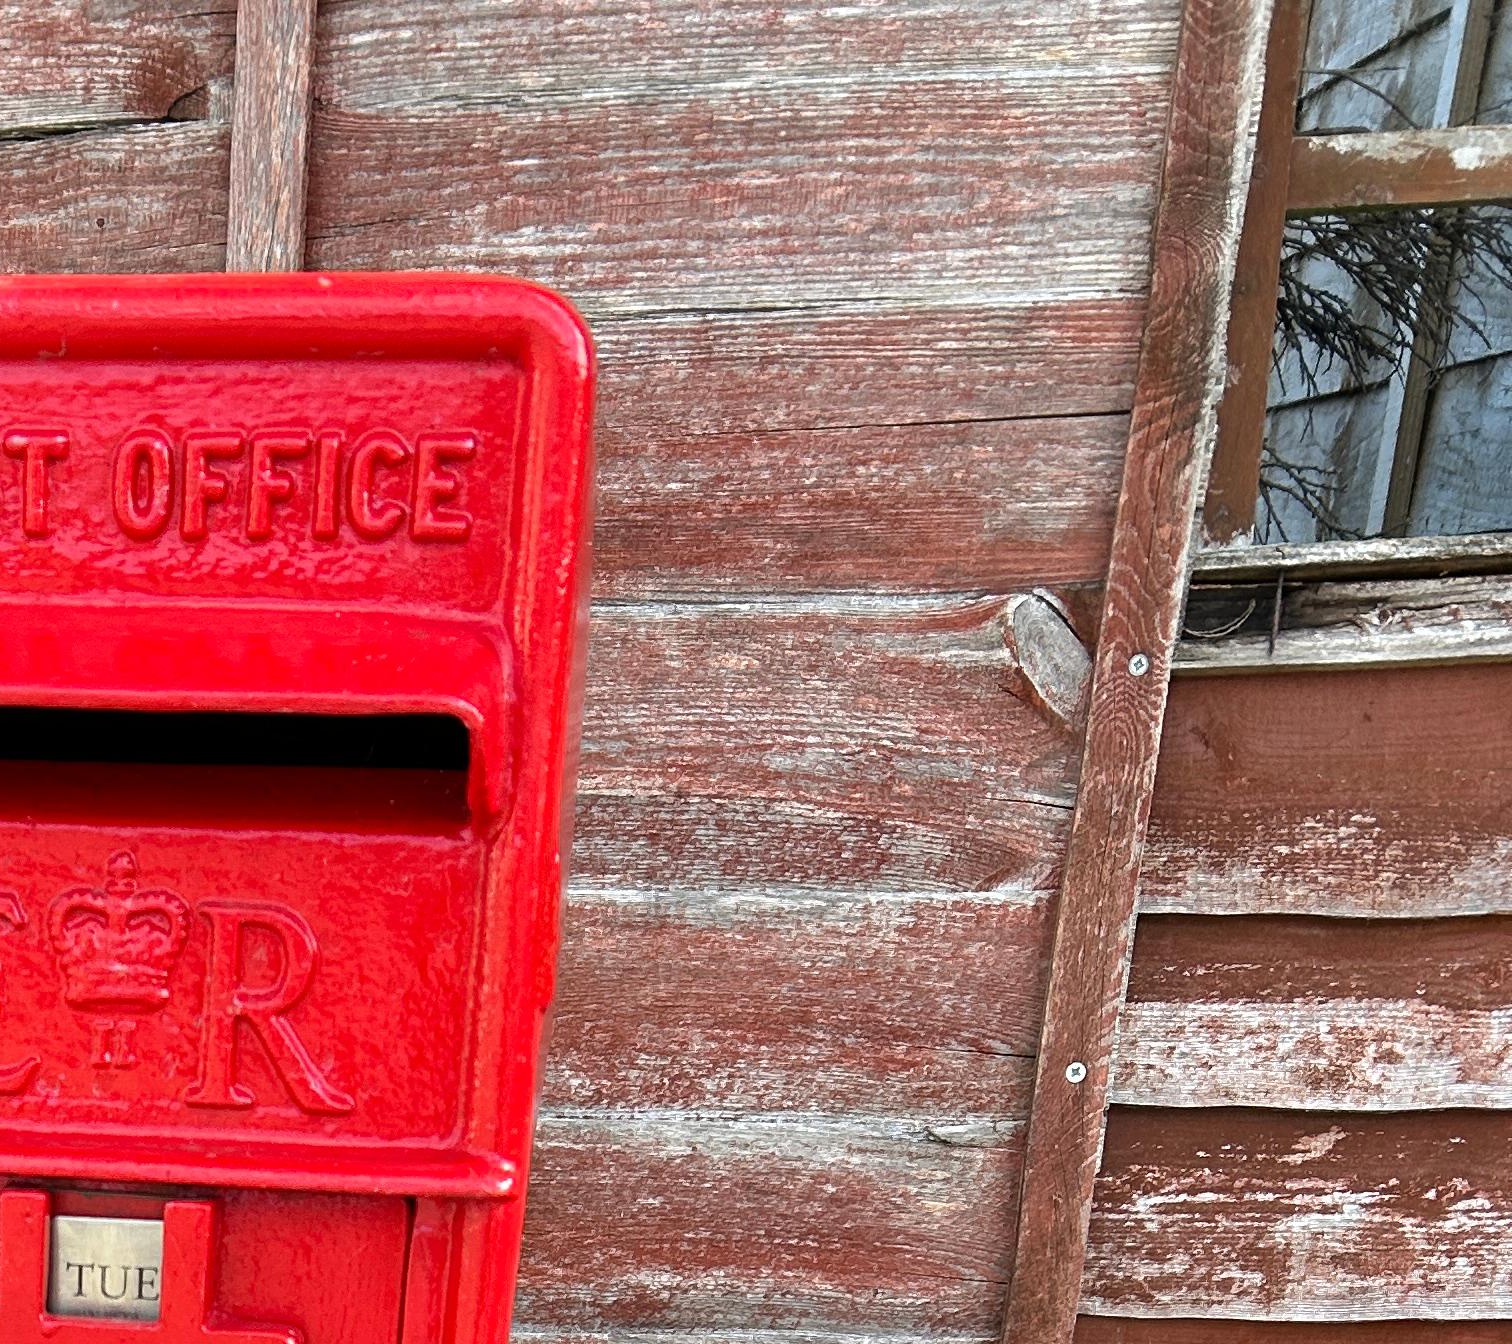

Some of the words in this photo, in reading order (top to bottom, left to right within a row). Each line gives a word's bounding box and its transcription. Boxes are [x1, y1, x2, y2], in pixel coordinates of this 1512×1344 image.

[112, 426, 479, 545] OFFICE
[185, 900, 358, 1114] R
[66, 1262, 160, 1301] TUE
